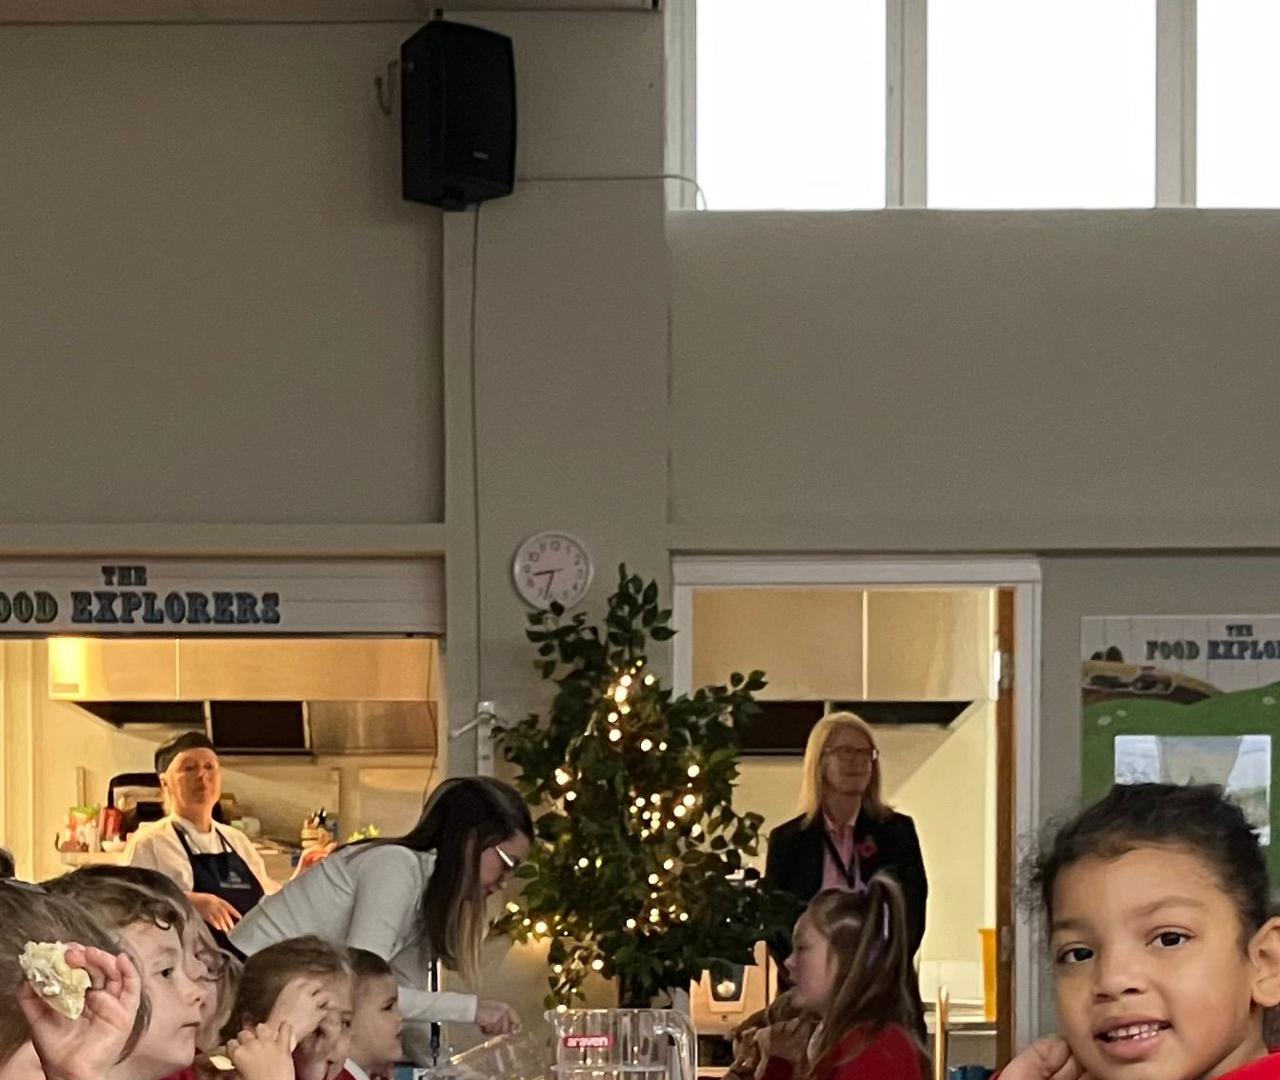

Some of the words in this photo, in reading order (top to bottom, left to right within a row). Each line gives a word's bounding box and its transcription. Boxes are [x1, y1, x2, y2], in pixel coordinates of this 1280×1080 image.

[101, 565, 148, 587] THE
[70, 591, 282, 625] EXPLORERS
[1225, 624, 1254, 638] THE
[1146, 640, 1201, 661] FOOD
